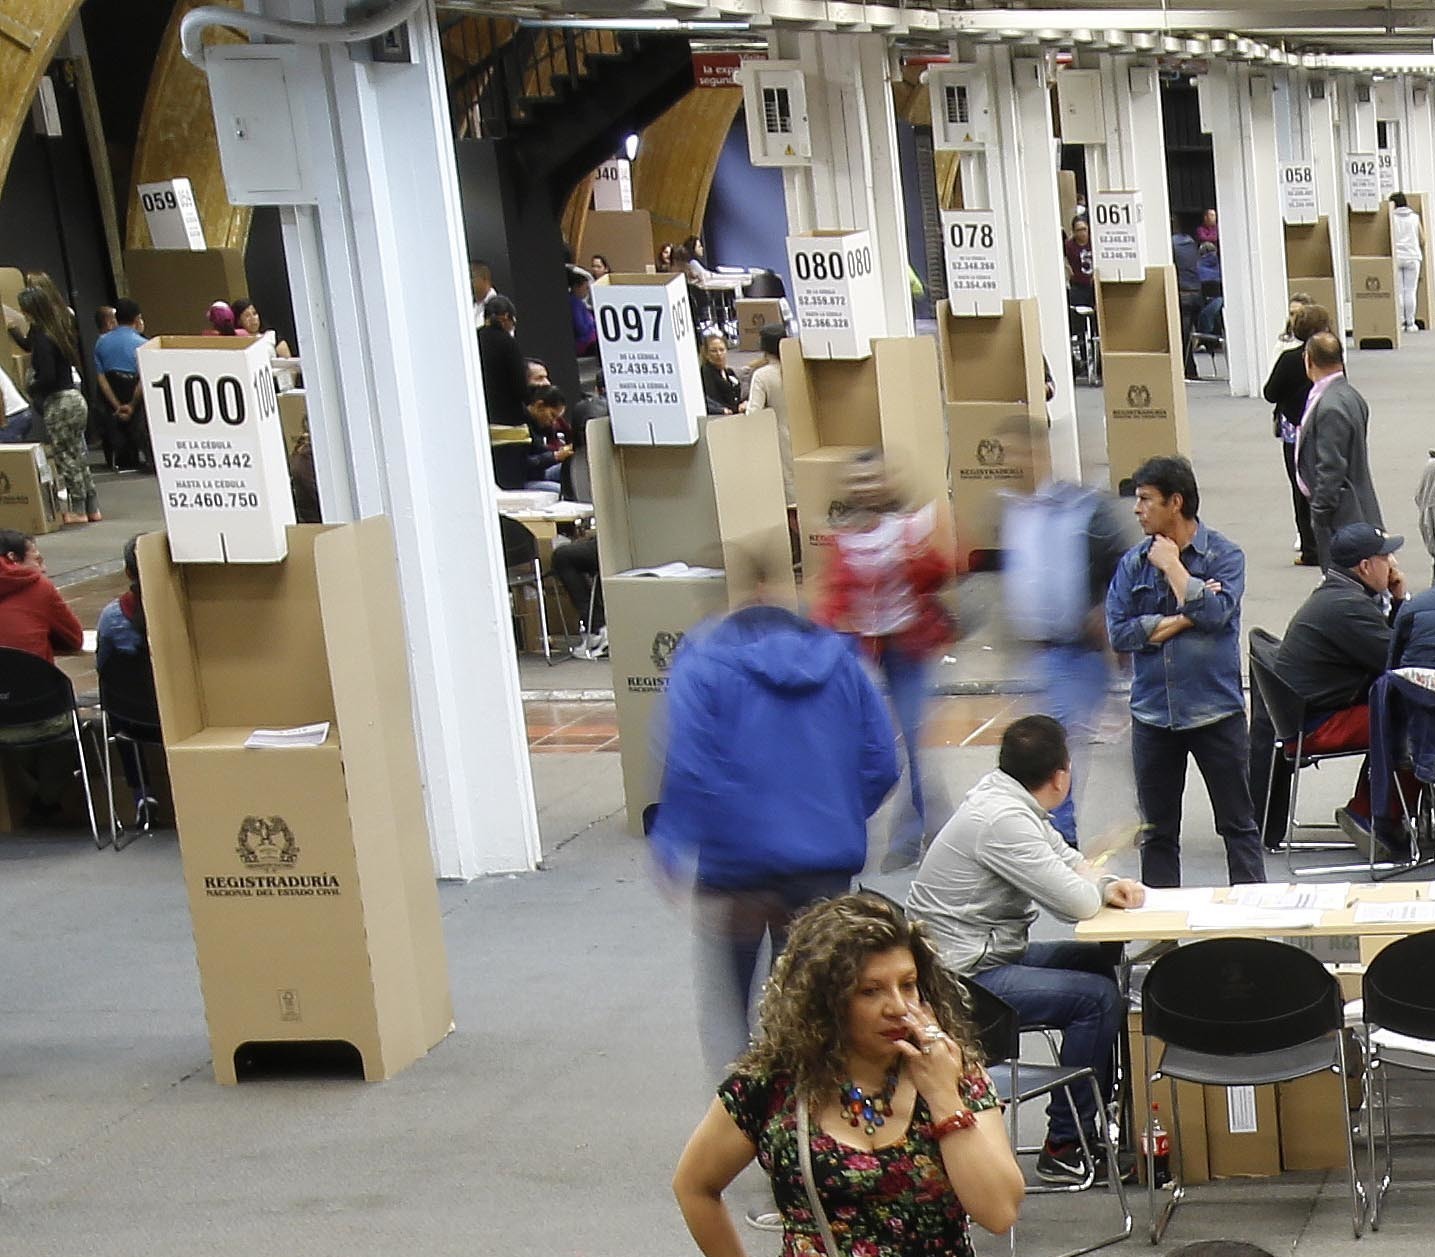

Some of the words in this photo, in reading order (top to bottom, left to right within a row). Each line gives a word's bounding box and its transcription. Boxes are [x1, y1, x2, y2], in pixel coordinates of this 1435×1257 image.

[1285, 167, 1312, 183] 058
[1351, 161, 1375, 175] 042
[142, 191, 176, 213] 059
[1096, 204, 1130, 224] 061
[950, 224, 993, 248] 078
[795, 251, 844, 280] 080
[847, 246, 871, 279] 080
[599, 305, 663, 342] 097
[671, 296, 690, 341] 097
[152, 373, 245, 425] 100
[254, 366, 275, 421] 100
[614, 392, 679, 404] 52.445.120
[189, 441, 200, 449] LA
[162, 453, 252, 468] 52.455.442
[176, 480, 200, 488] HASTA
[203, 480, 212, 488] LA
[168, 492, 258, 508] 52.460.750
[204, 872, 340, 889] REGISTRADURÍA
